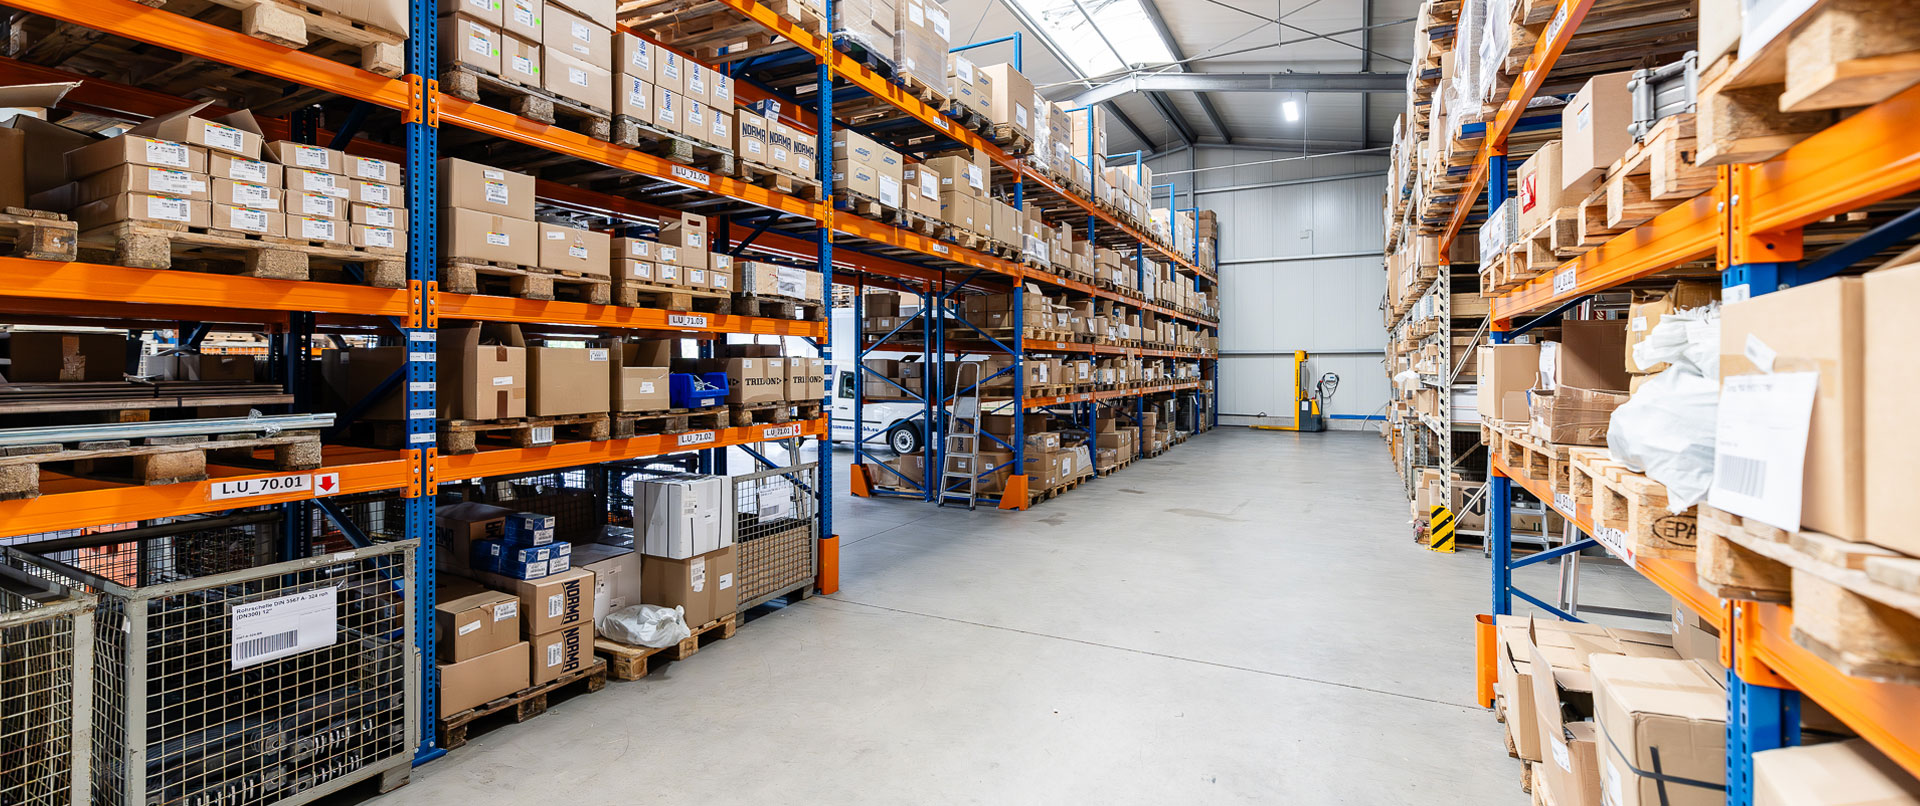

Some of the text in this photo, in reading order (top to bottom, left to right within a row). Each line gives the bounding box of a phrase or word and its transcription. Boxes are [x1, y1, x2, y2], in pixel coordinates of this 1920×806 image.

[742, 122, 766, 144] NORMA
[769, 131, 792, 152] NORMA
[794, 141, 814, 160] NORMA
[672, 315, 704, 326] L.U_71.03
[792, 375, 819, 384] TRION
[681, 432, 712, 444] L.U_71.02
[766, 427, 790, 438] L.U_71.01
[222, 476, 303, 495] L.U_70.01
[1664, 520, 1697, 539] EPA
[273, 599, 285, 607] DIN
[286, 596, 300, 604] 3567
[563, 579, 580, 625] NORMA
[236, 611, 261, 621] (DN300)
[563, 626, 580, 674] NORMA
